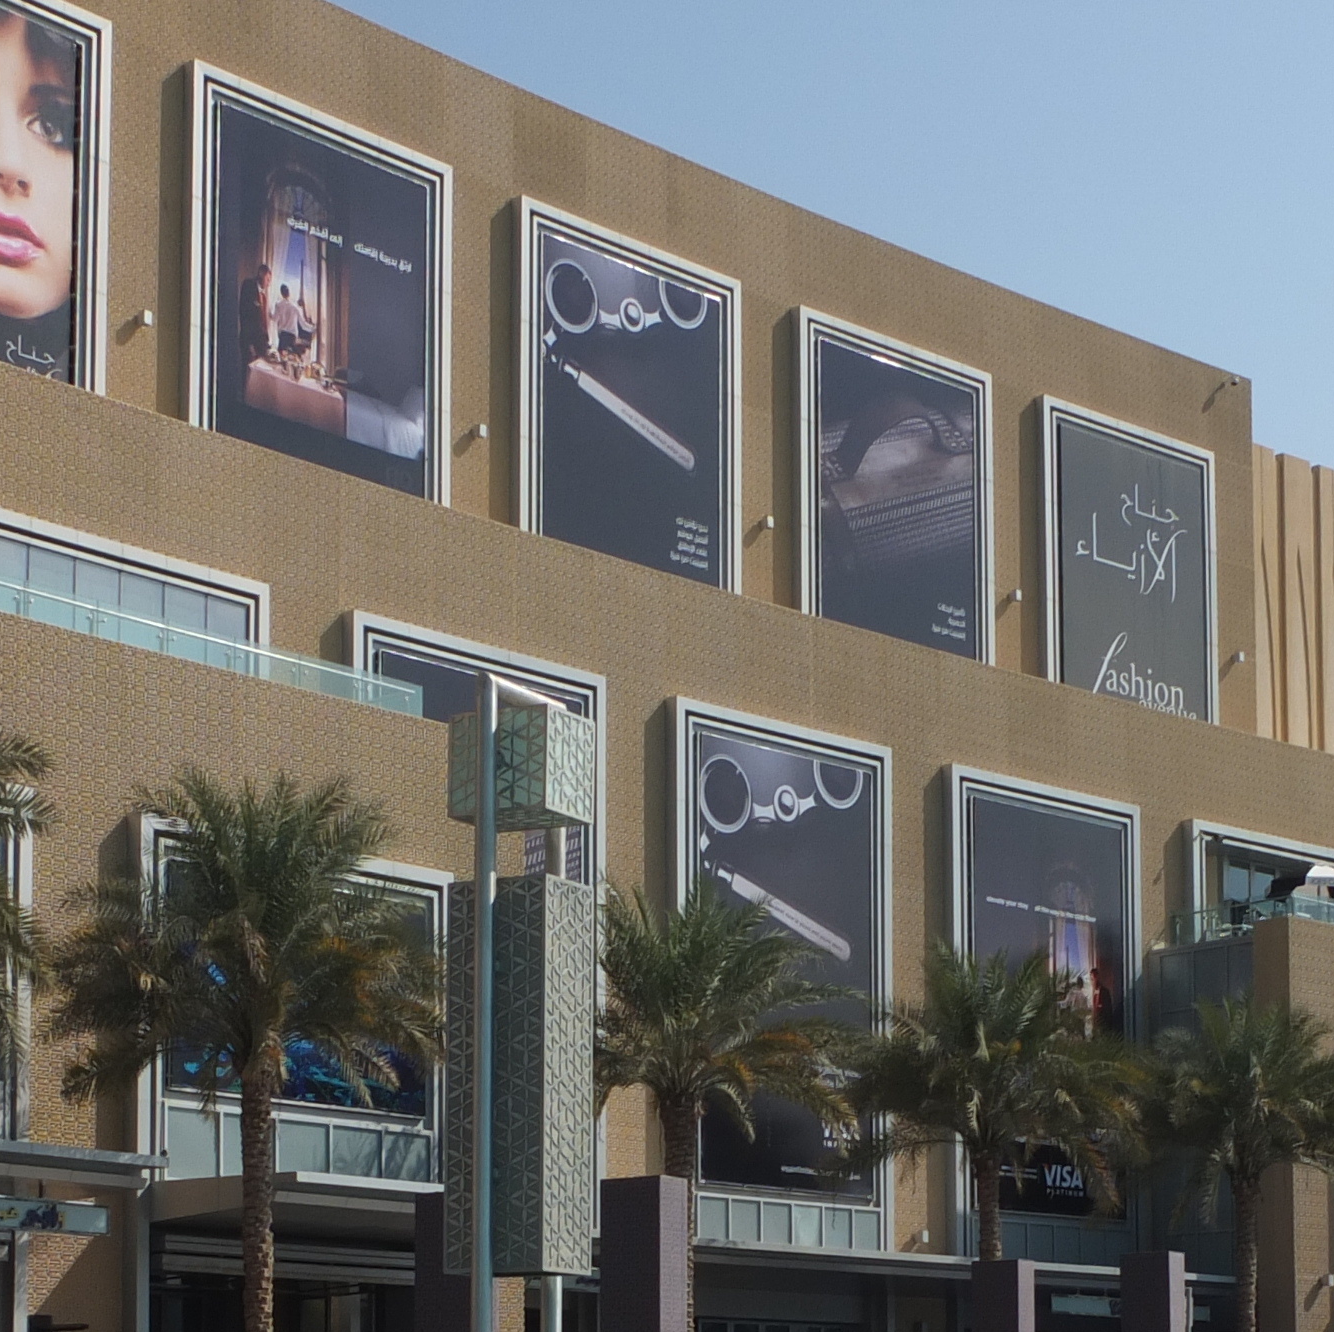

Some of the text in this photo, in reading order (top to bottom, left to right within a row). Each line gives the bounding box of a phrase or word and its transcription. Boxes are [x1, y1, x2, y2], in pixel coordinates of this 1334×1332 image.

[5, 334, 56, 369] جناح
[1120, 483, 1179, 530] جناح
[1075, 511, 1188, 603] الأزياء
[1092, 631, 1184, 708] fashion
[1042, 1162, 1084, 1189] VISA
